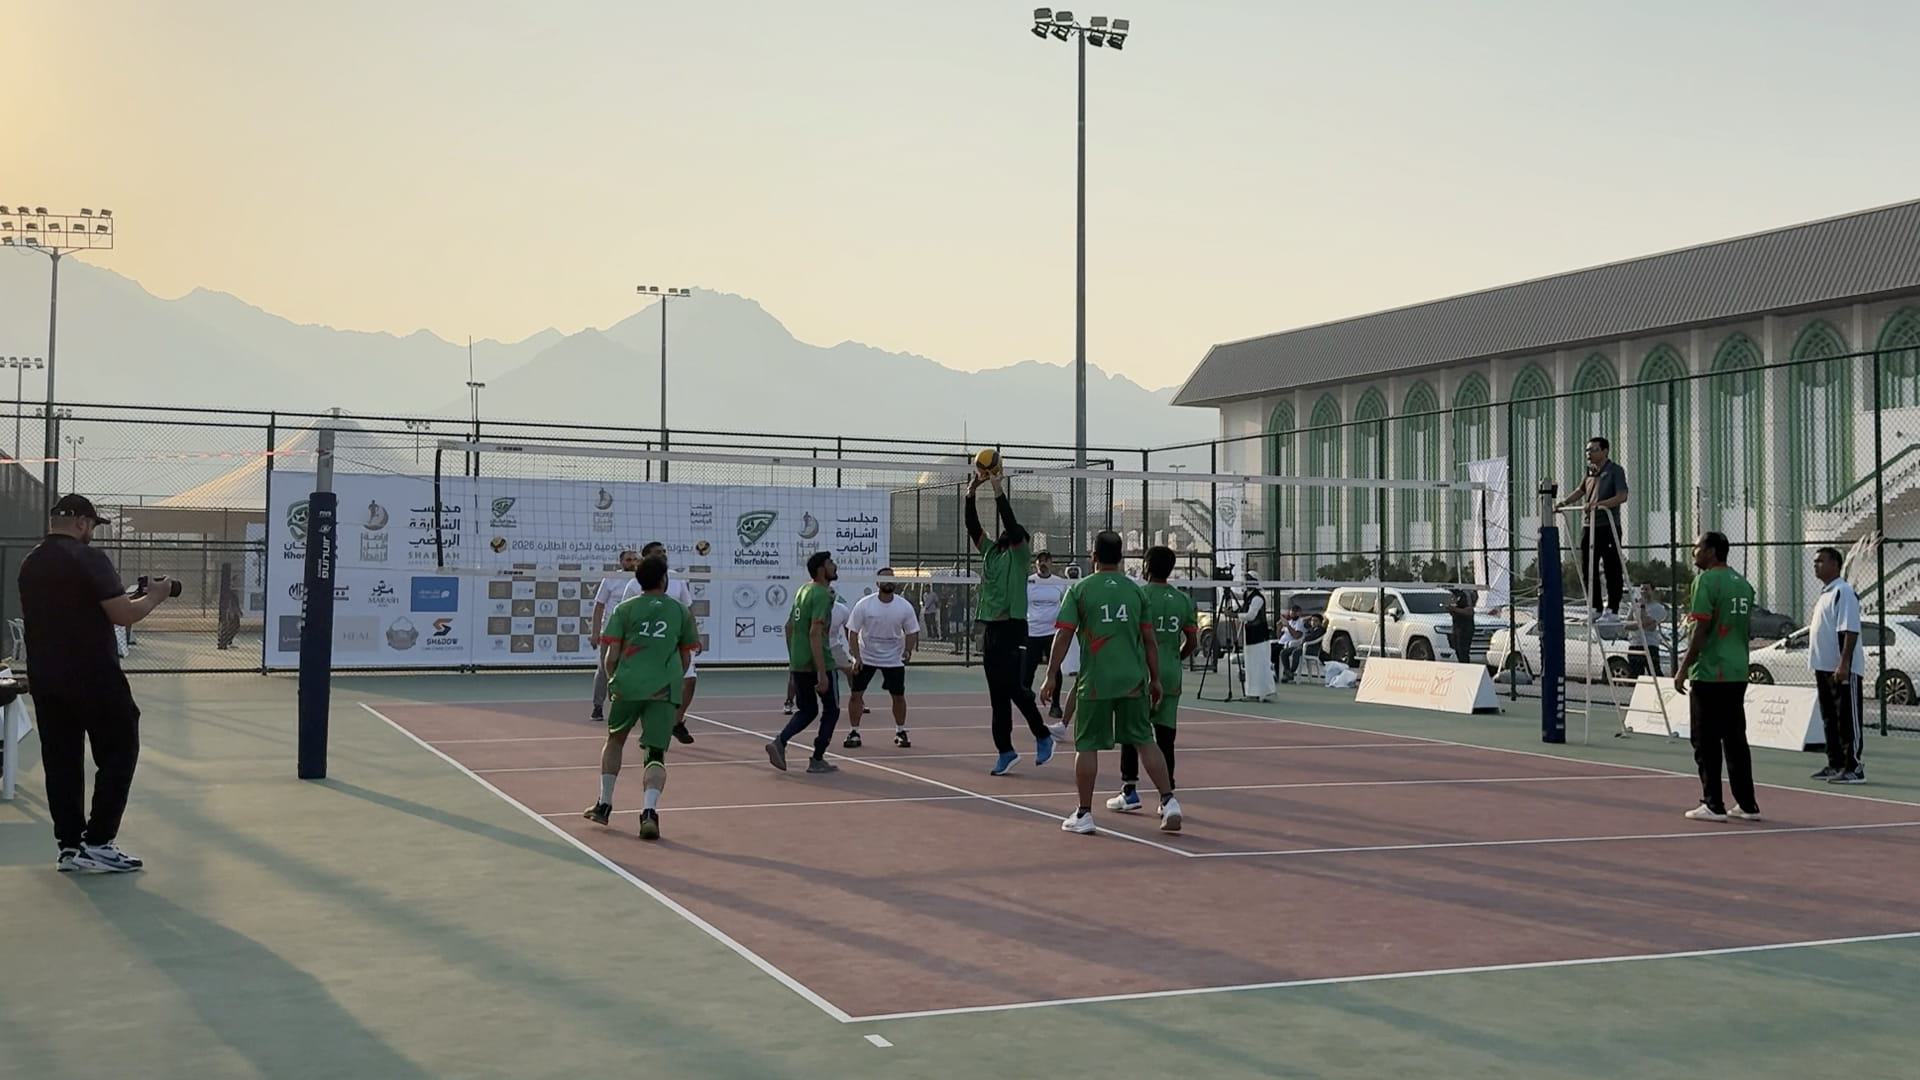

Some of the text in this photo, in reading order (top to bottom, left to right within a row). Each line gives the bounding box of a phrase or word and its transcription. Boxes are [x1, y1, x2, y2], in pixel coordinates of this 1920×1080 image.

[410, 502, 461, 516] مجس
[836, 512, 878, 525] مجلس
[408, 534, 460, 548] الريضي
[836, 527, 878, 541] الشارقة
[512, 540, 535, 550] 2026
[836, 542, 877, 555] الرياضي
[1730, 597, 1748, 614] 15
[794, 608, 801, 621] 9
[1100, 603, 1129, 623] 14
[638, 621, 668, 638] 12
[1156, 615, 1180, 632] 13
